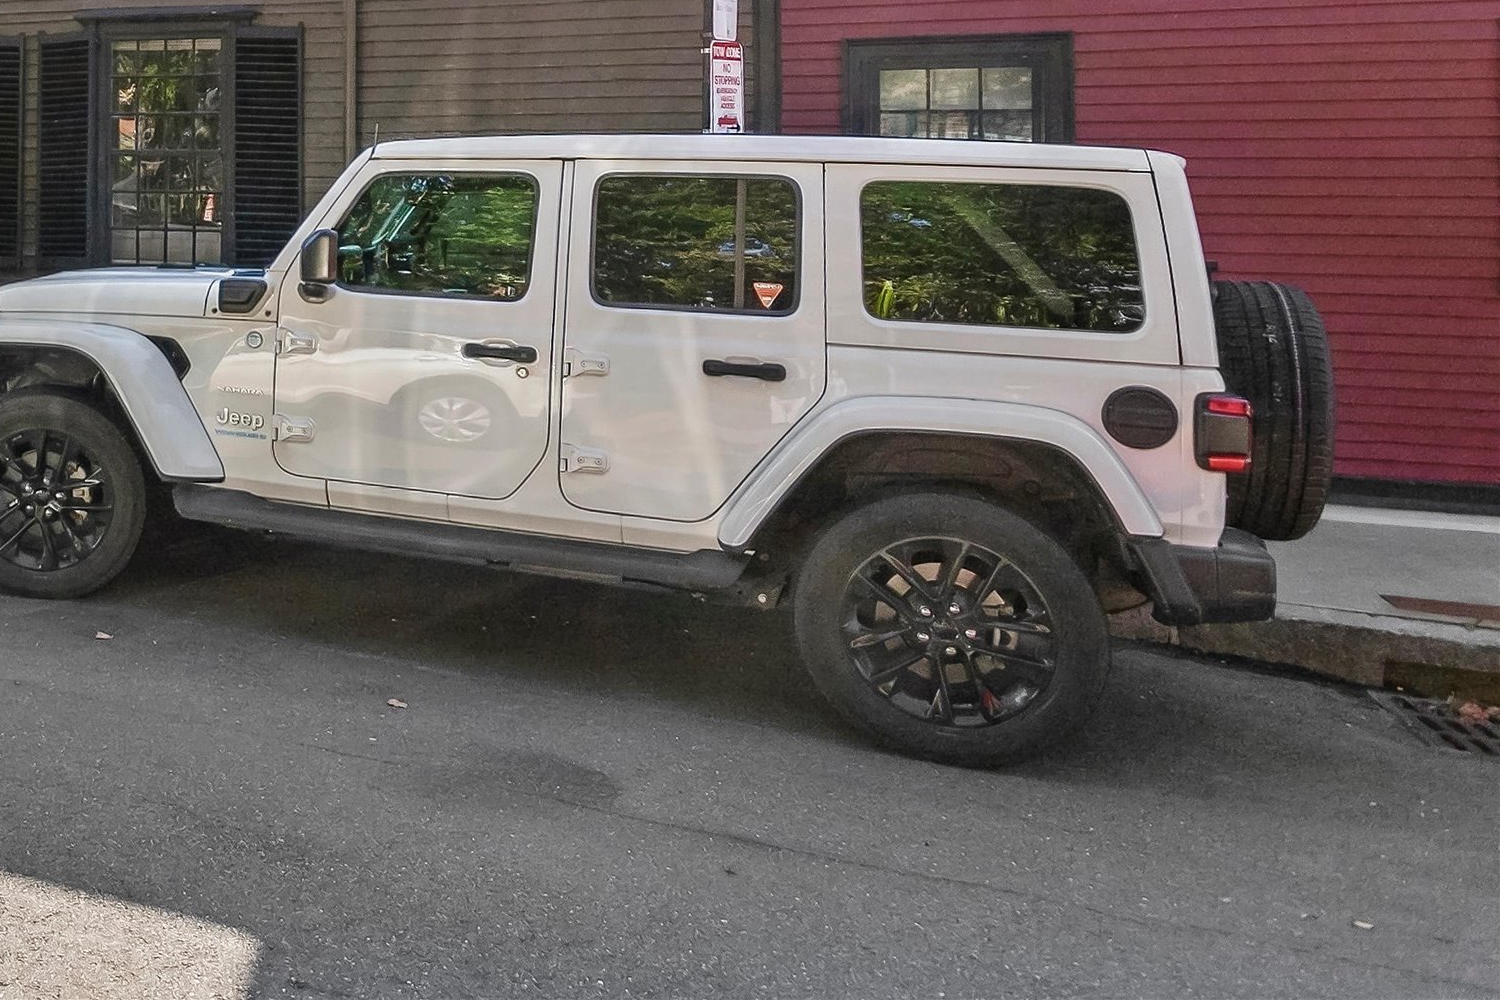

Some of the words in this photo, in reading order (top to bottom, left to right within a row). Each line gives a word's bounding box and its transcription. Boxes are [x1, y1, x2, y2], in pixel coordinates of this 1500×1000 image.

[723, 64, 731, 73] NO
[715, 76, 740, 86] STOPPING
[216, 407, 264, 430] Jeep
